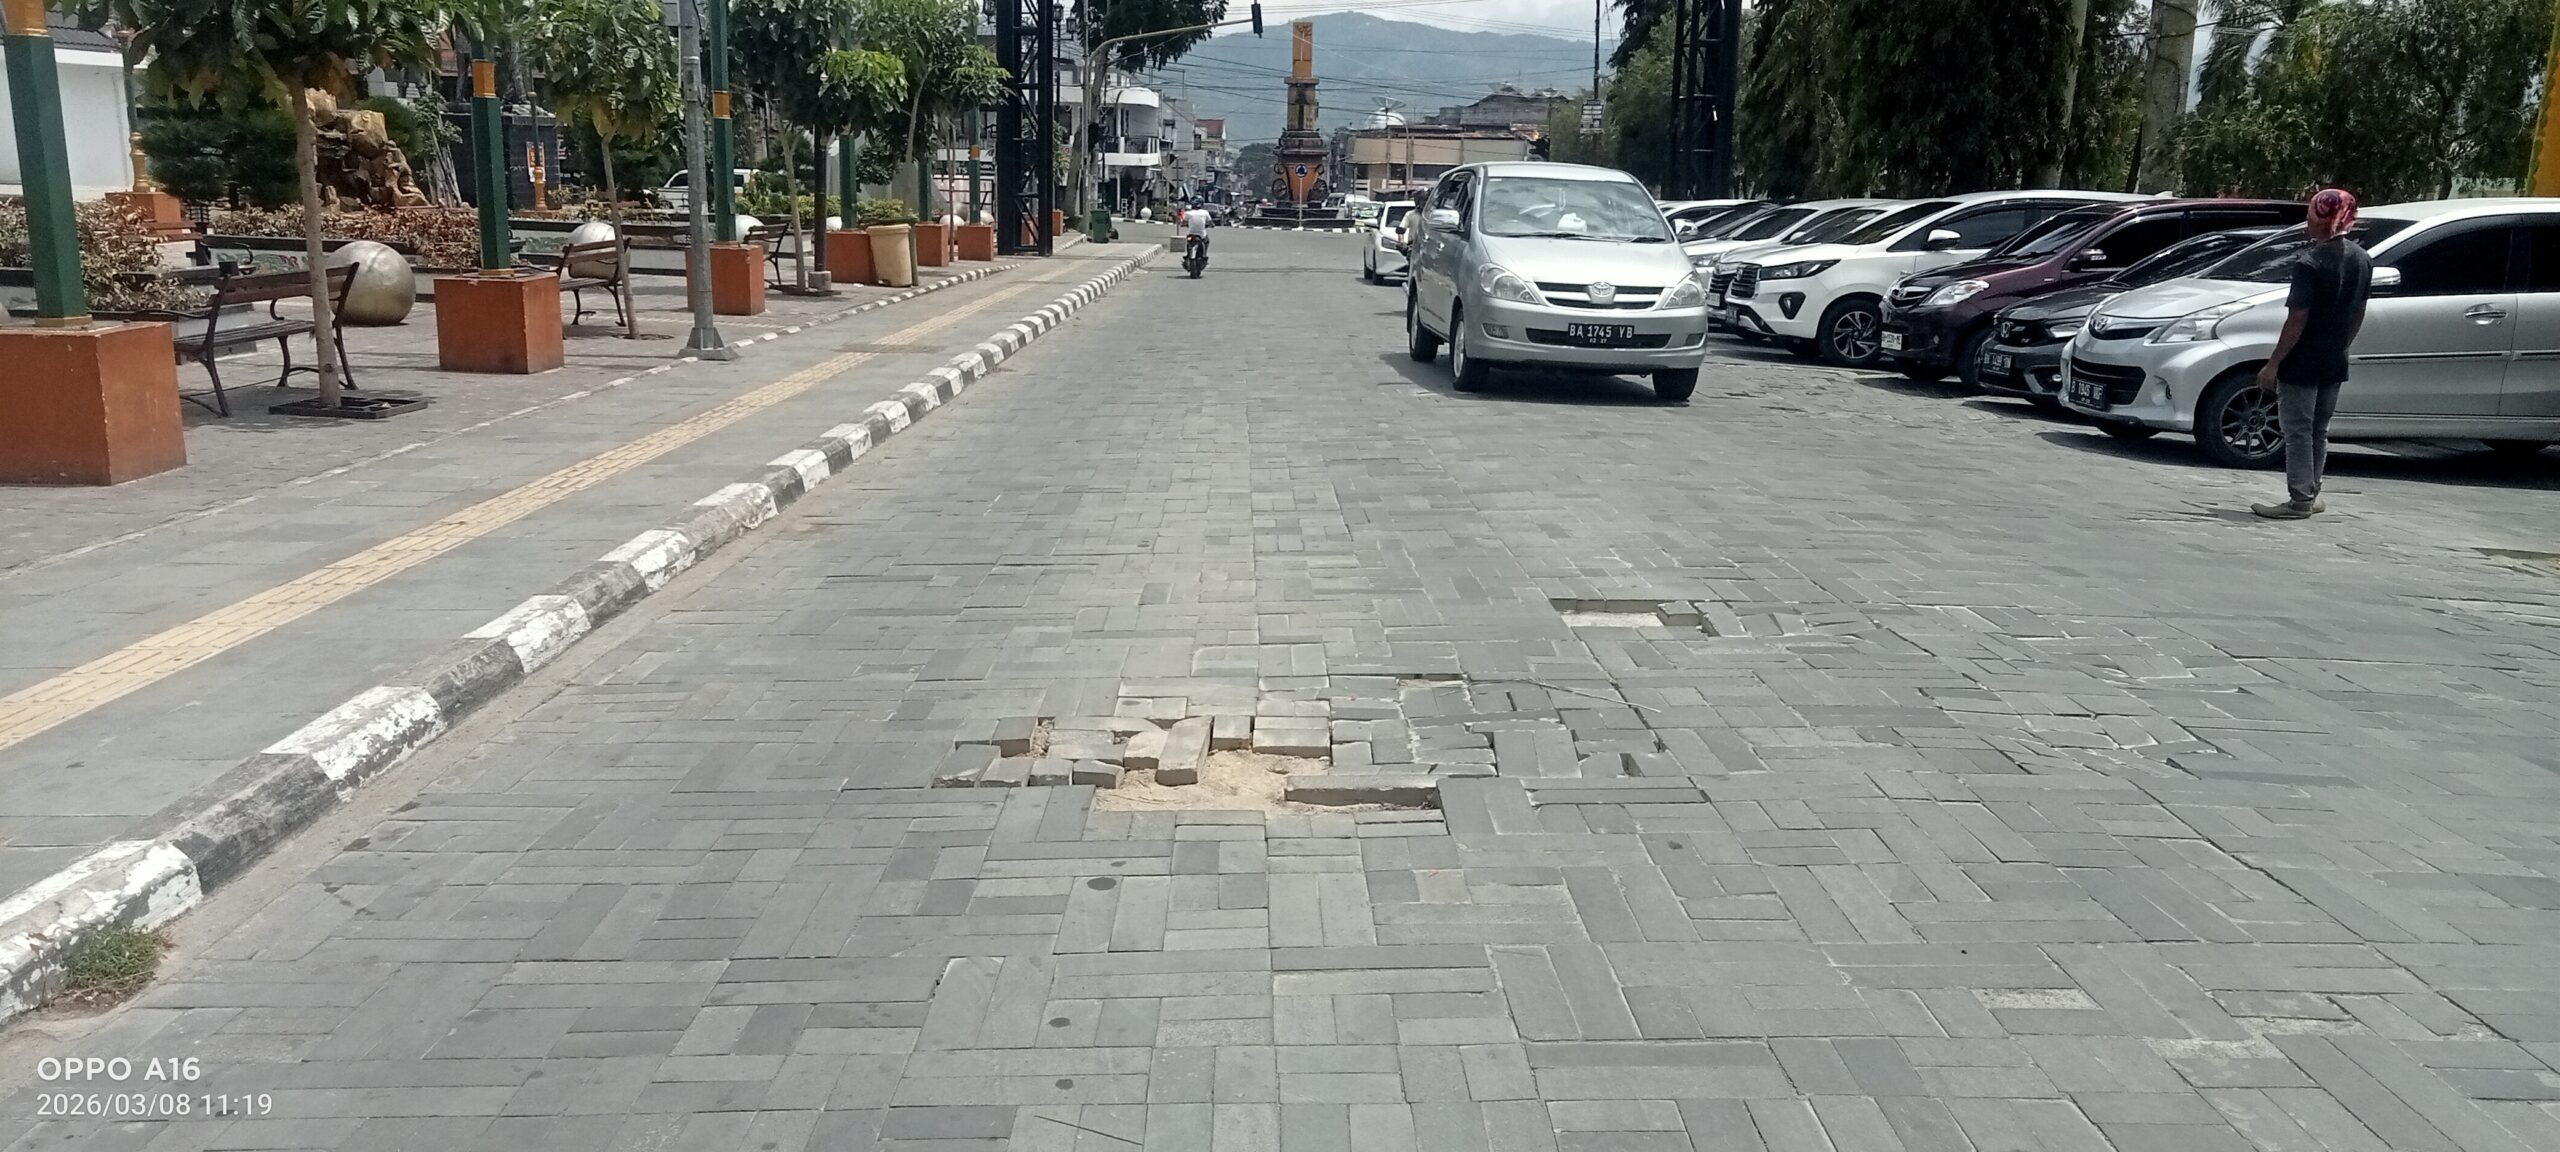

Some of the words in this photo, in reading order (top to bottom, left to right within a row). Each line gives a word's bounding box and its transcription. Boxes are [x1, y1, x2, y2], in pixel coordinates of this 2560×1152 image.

[1569, 324, 1584, 337] BA
[1587, 325, 1612, 338] 1745
[1619, 326, 1633, 339] YB
